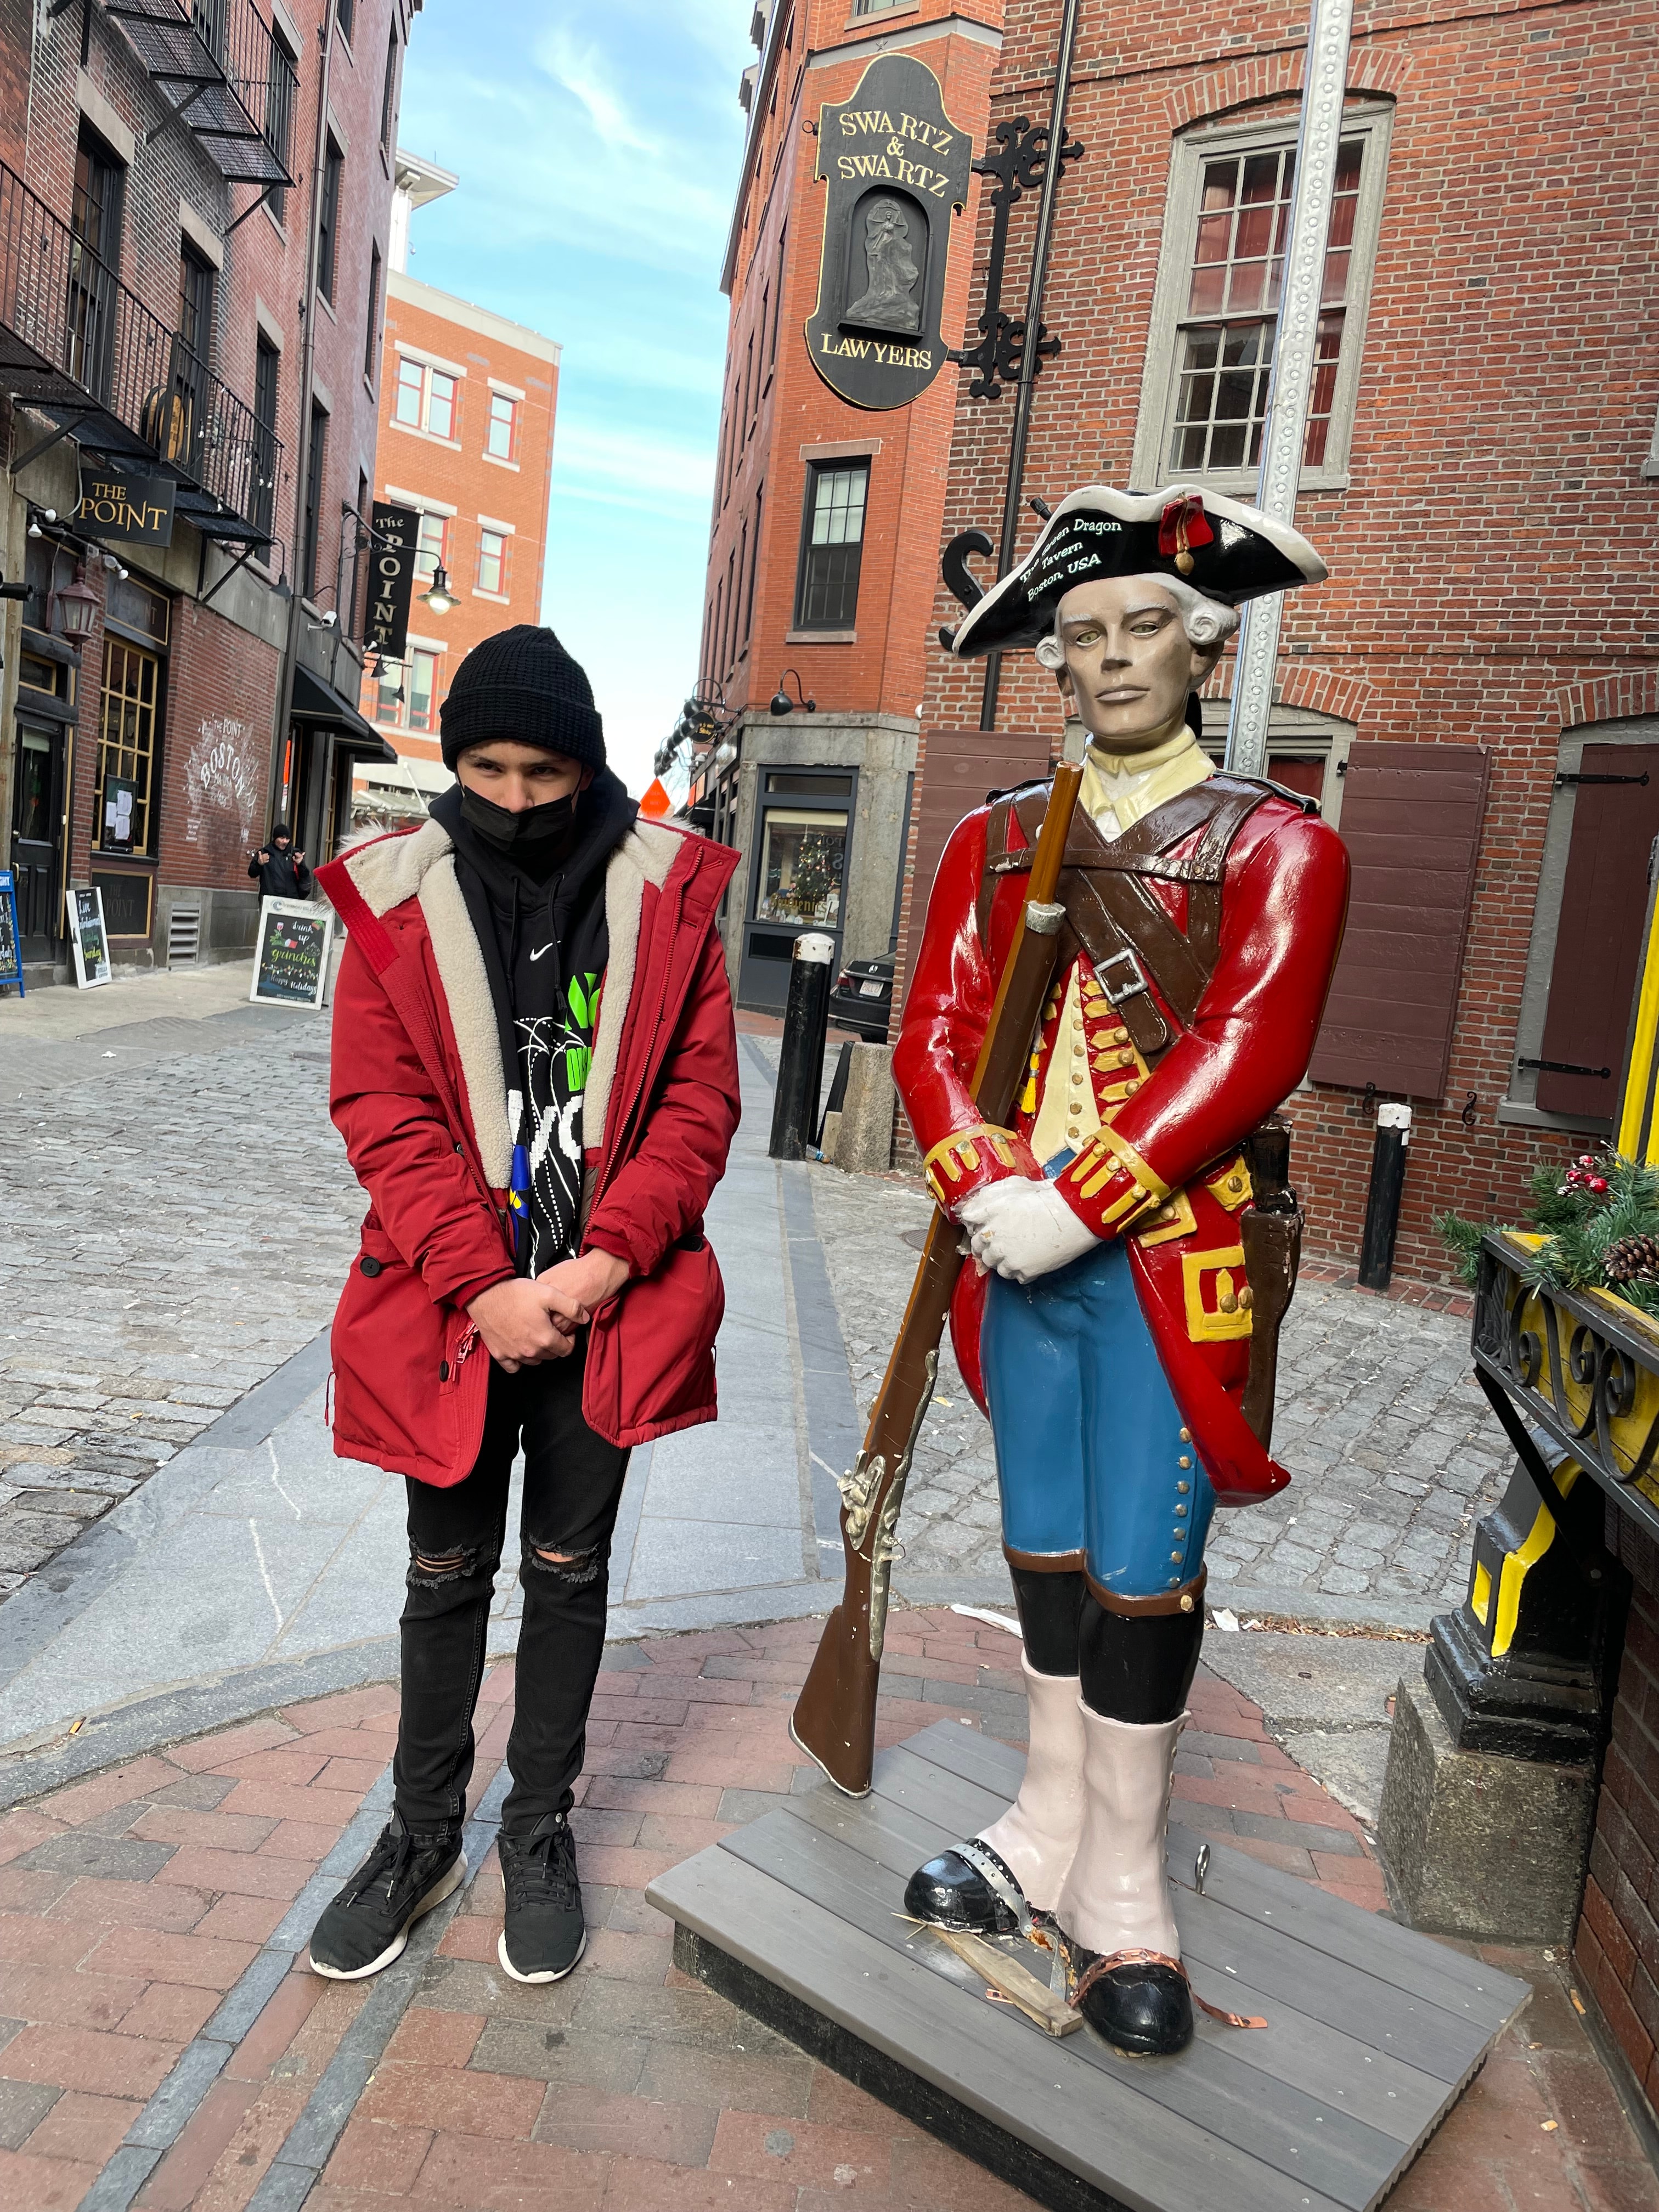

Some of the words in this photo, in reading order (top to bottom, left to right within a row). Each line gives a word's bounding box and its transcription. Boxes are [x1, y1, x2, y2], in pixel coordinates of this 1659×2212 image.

[839, 110, 954, 155] SWARTZ
[886, 136, 905, 157] &
[837, 155, 951, 198] SWARTZ
[820, 332, 933, 370] LAWYERS
[92, 482, 127, 501] THE
[78, 497, 168, 532] POINT
[376, 516, 405, 529] The
[1073, 518, 1122, 536] Dragon
[1041, 541, 1084, 570] Tavern
[373, 533, 404, 646] POINT
[1027, 572, 1065, 602] Boston,
[1067, 553, 1102, 574] USA
[223, 719, 242, 738] POINT
[292, 921, 314, 934] drink
[298, 934, 310, 945] up
